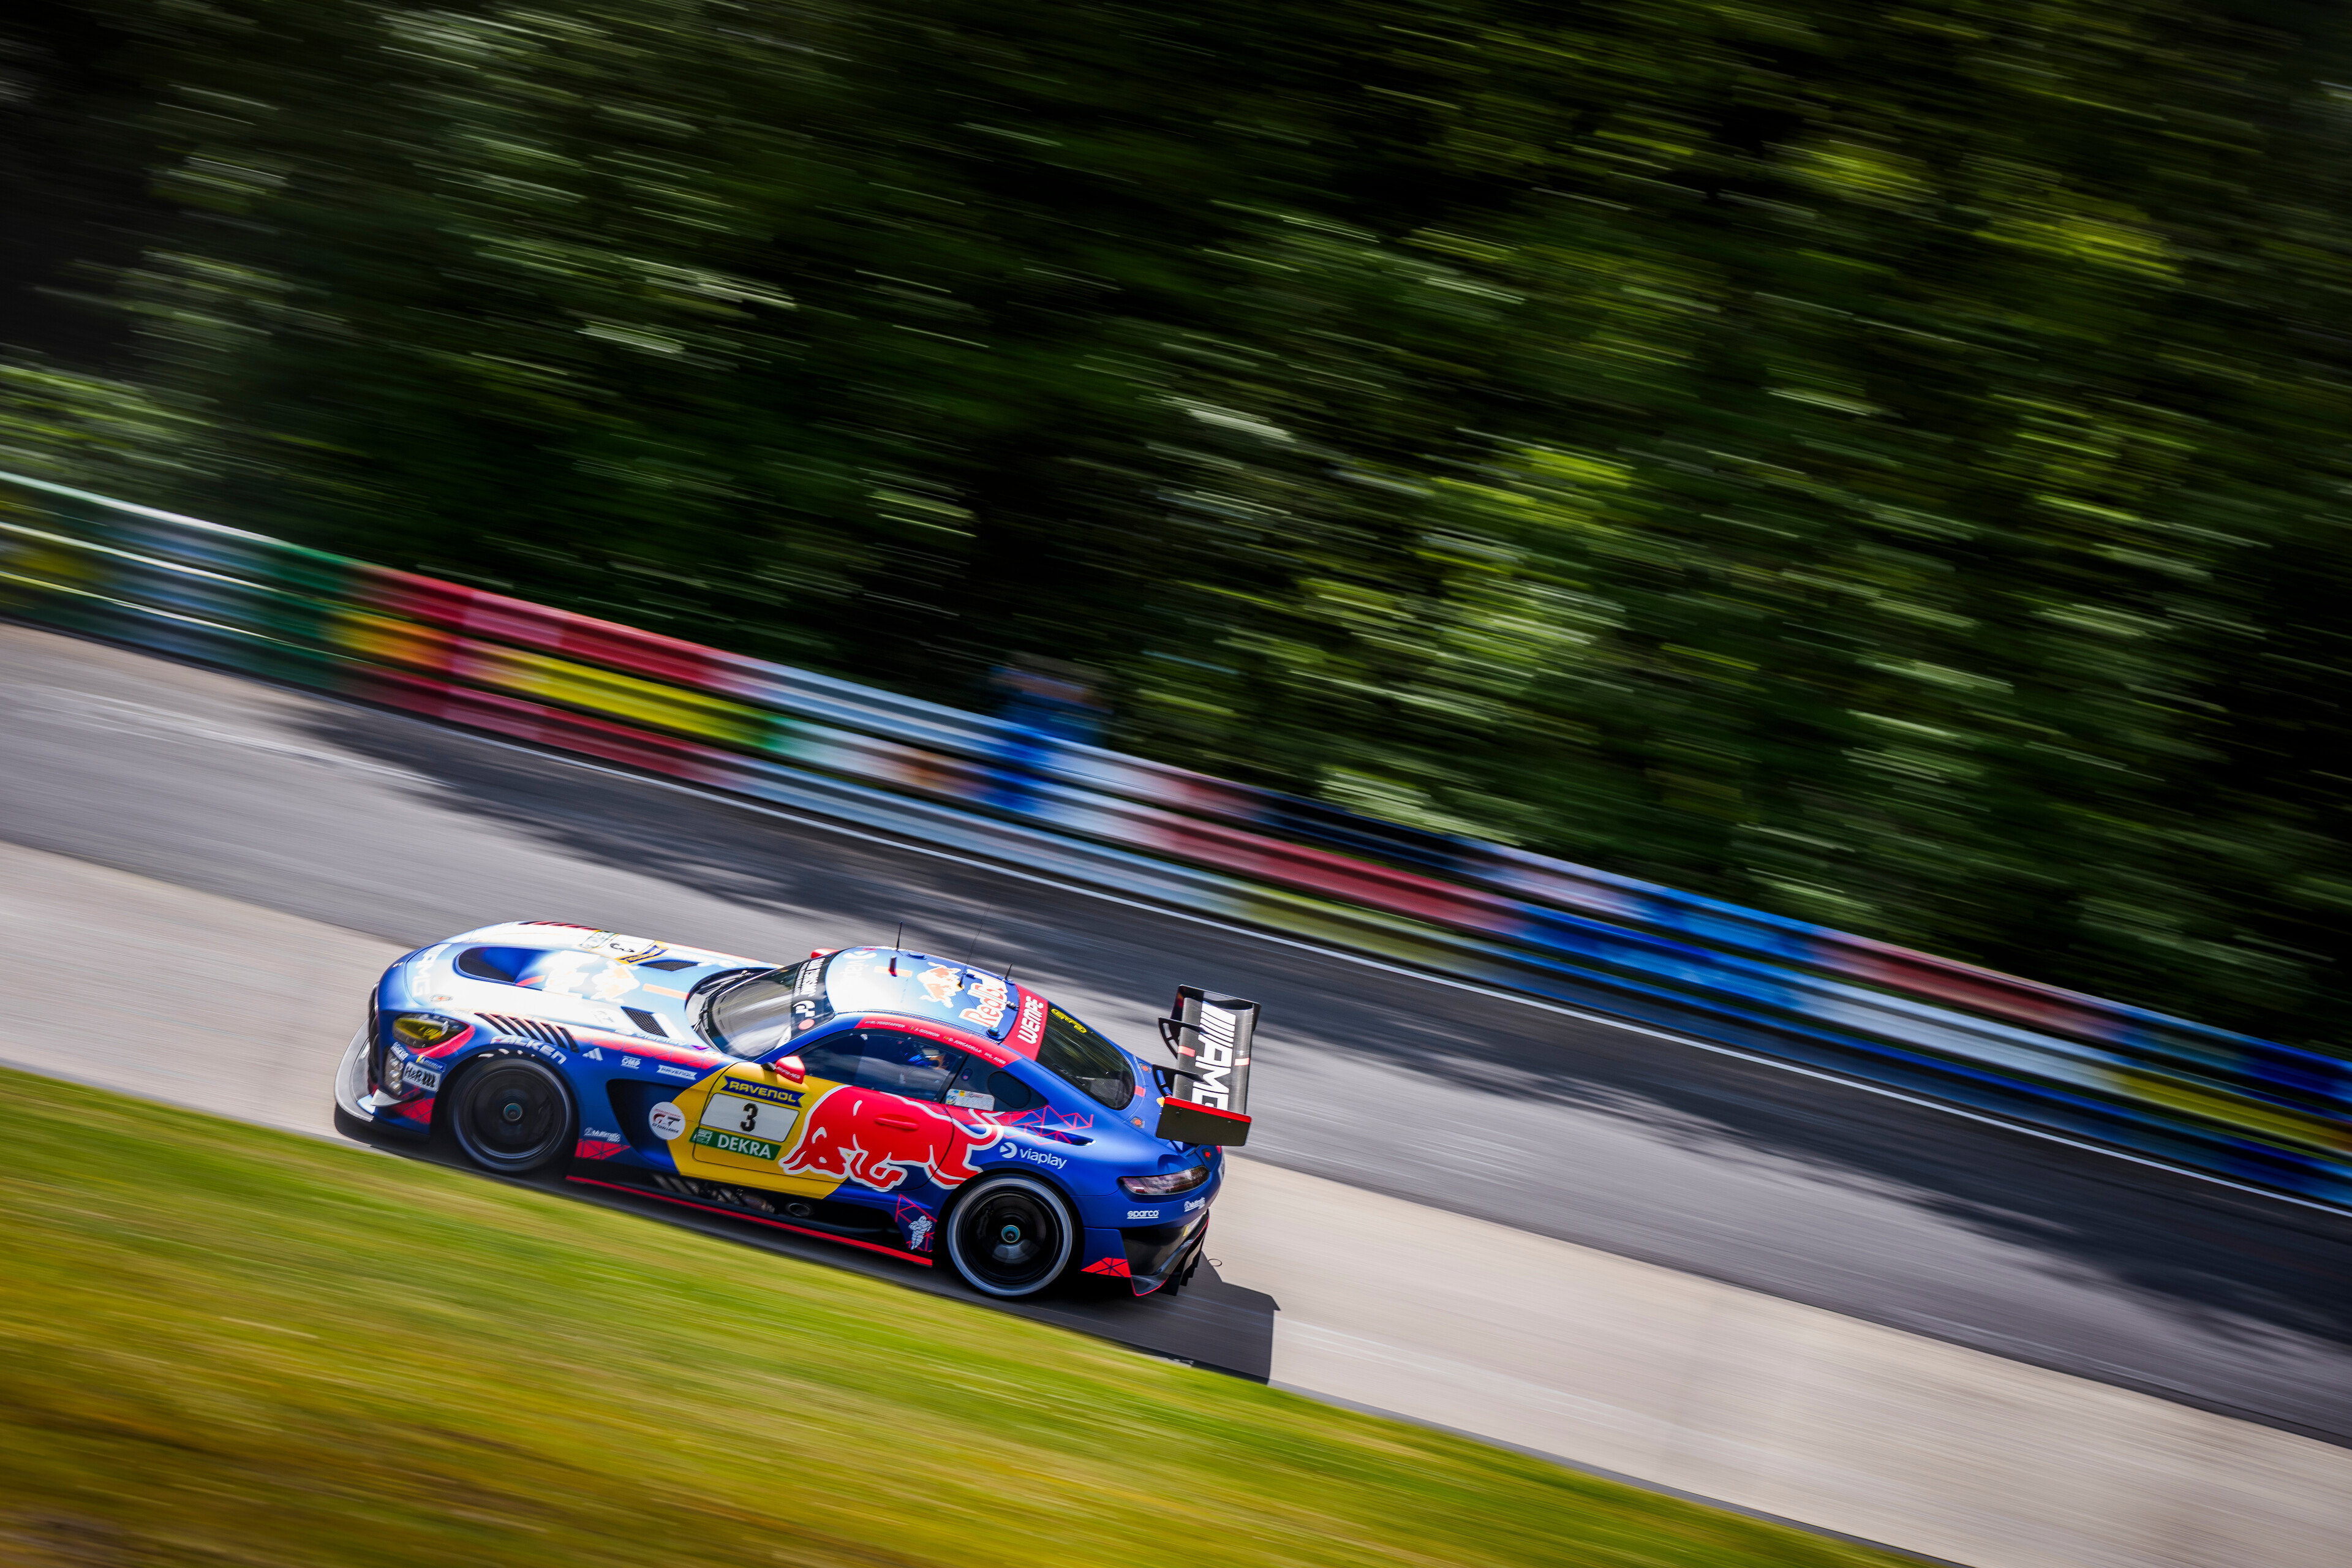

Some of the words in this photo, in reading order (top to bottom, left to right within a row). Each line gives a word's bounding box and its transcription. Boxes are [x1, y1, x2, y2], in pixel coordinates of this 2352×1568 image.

[1017, 995, 1044, 1044] WEMPE
[490, 1035, 567, 1065] FALKEN
[622, 1058, 641, 1068] OMP
[660, 1067, 694, 1079] RAVENOL
[782, 1068, 801, 1080] AMG
[1191, 1034, 1234, 1110] AMG
[729, 1081, 796, 1102] RAVENOL
[740, 1102, 758, 1132] 3
[717, 1134, 772, 1159] DEKRA
[1019, 1148, 1068, 1169] viaplay
